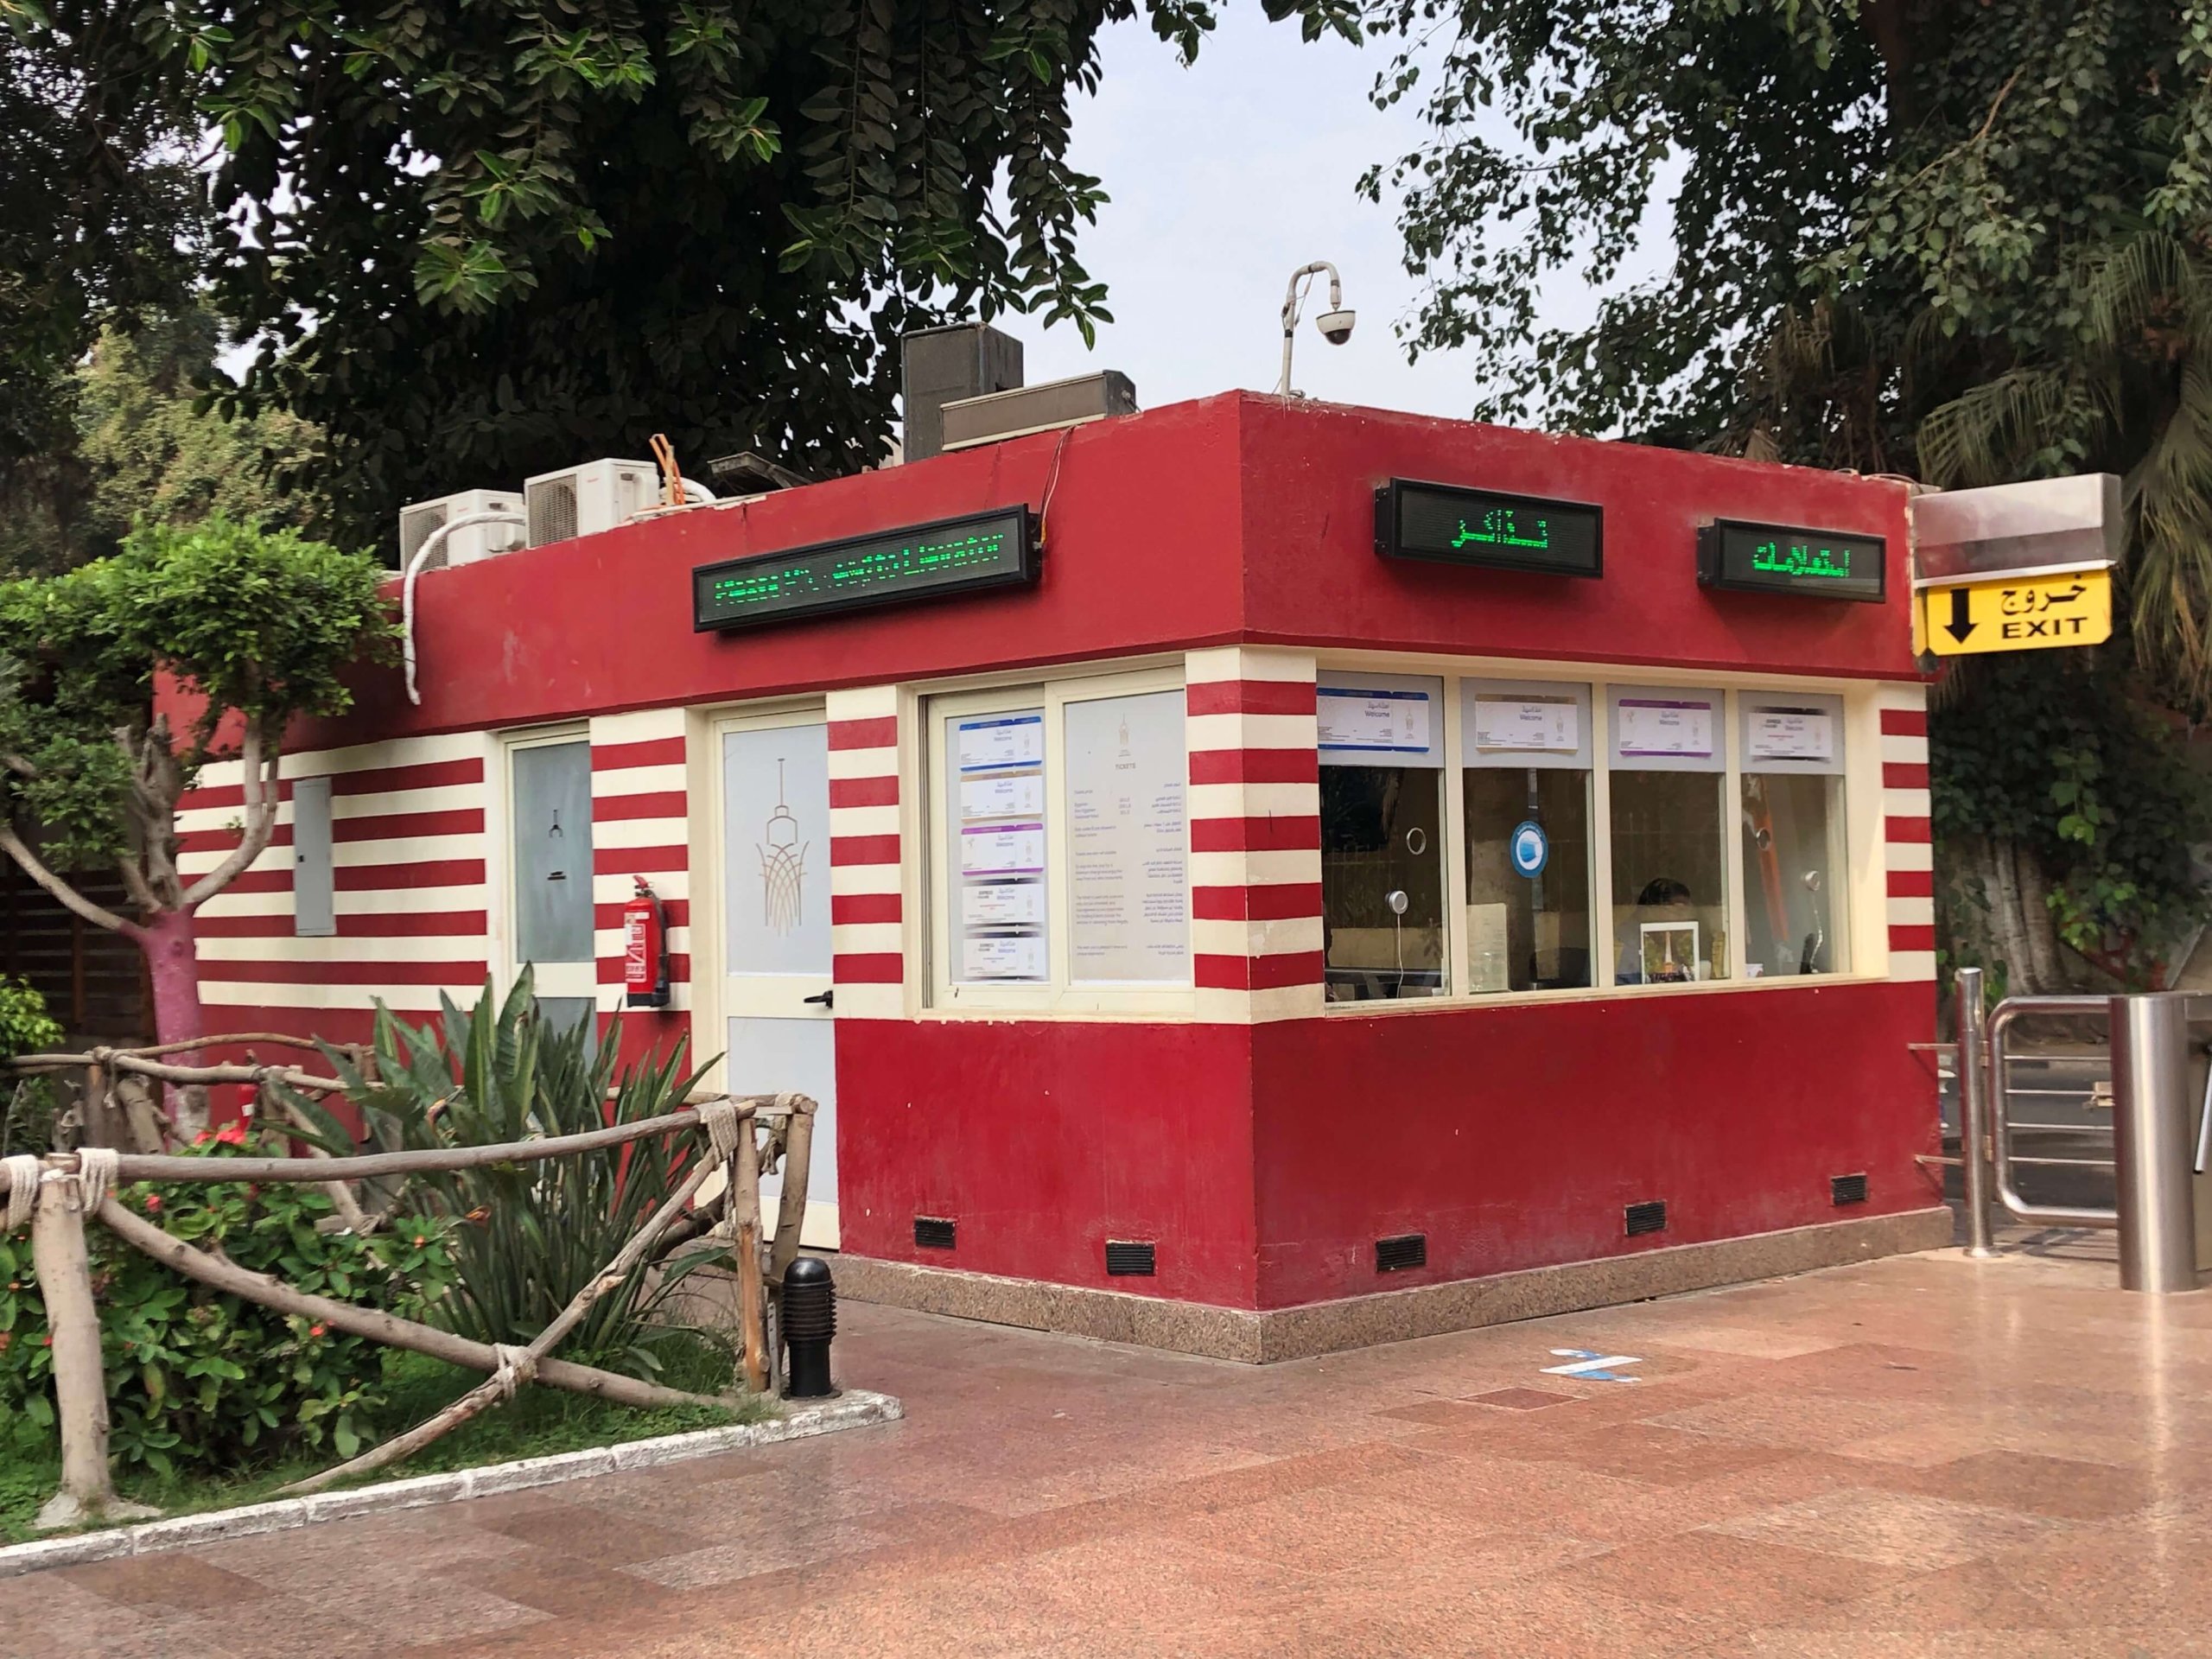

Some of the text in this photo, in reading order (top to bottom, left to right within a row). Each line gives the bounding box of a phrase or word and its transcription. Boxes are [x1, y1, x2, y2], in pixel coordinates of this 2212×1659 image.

[2000, 573, 2087, 616] خروج
[2001, 616, 2088, 639] EXIT
[1364, 709, 1390, 718] Welcome
